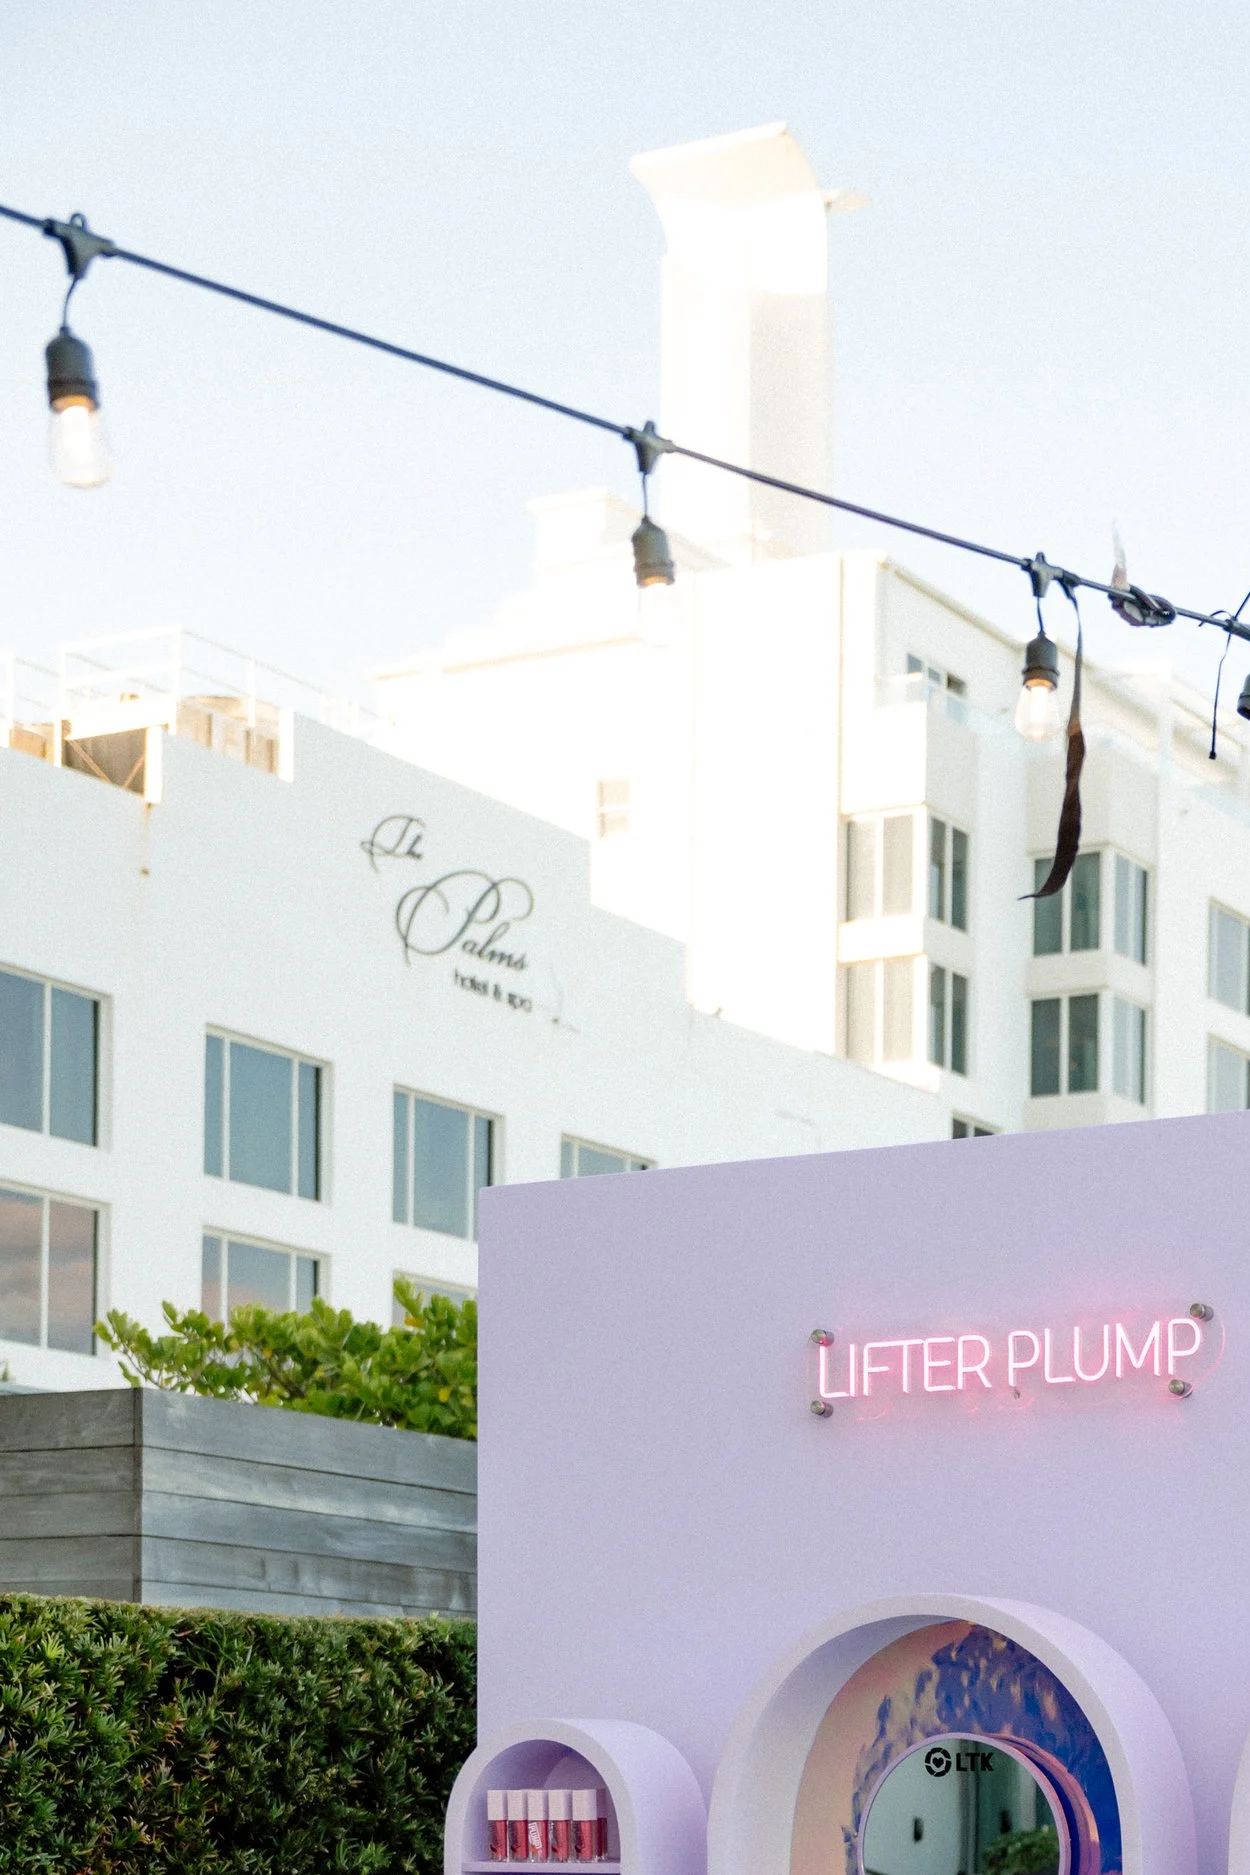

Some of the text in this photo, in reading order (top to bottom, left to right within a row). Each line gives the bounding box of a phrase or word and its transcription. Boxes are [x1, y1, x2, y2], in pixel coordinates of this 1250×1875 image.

[360, 815, 427, 874] The
[396, 869, 534, 971] Palms
[818, 1318, 1202, 1398] LIFTER PLUMP
[956, 1752, 994, 1772] LTK
